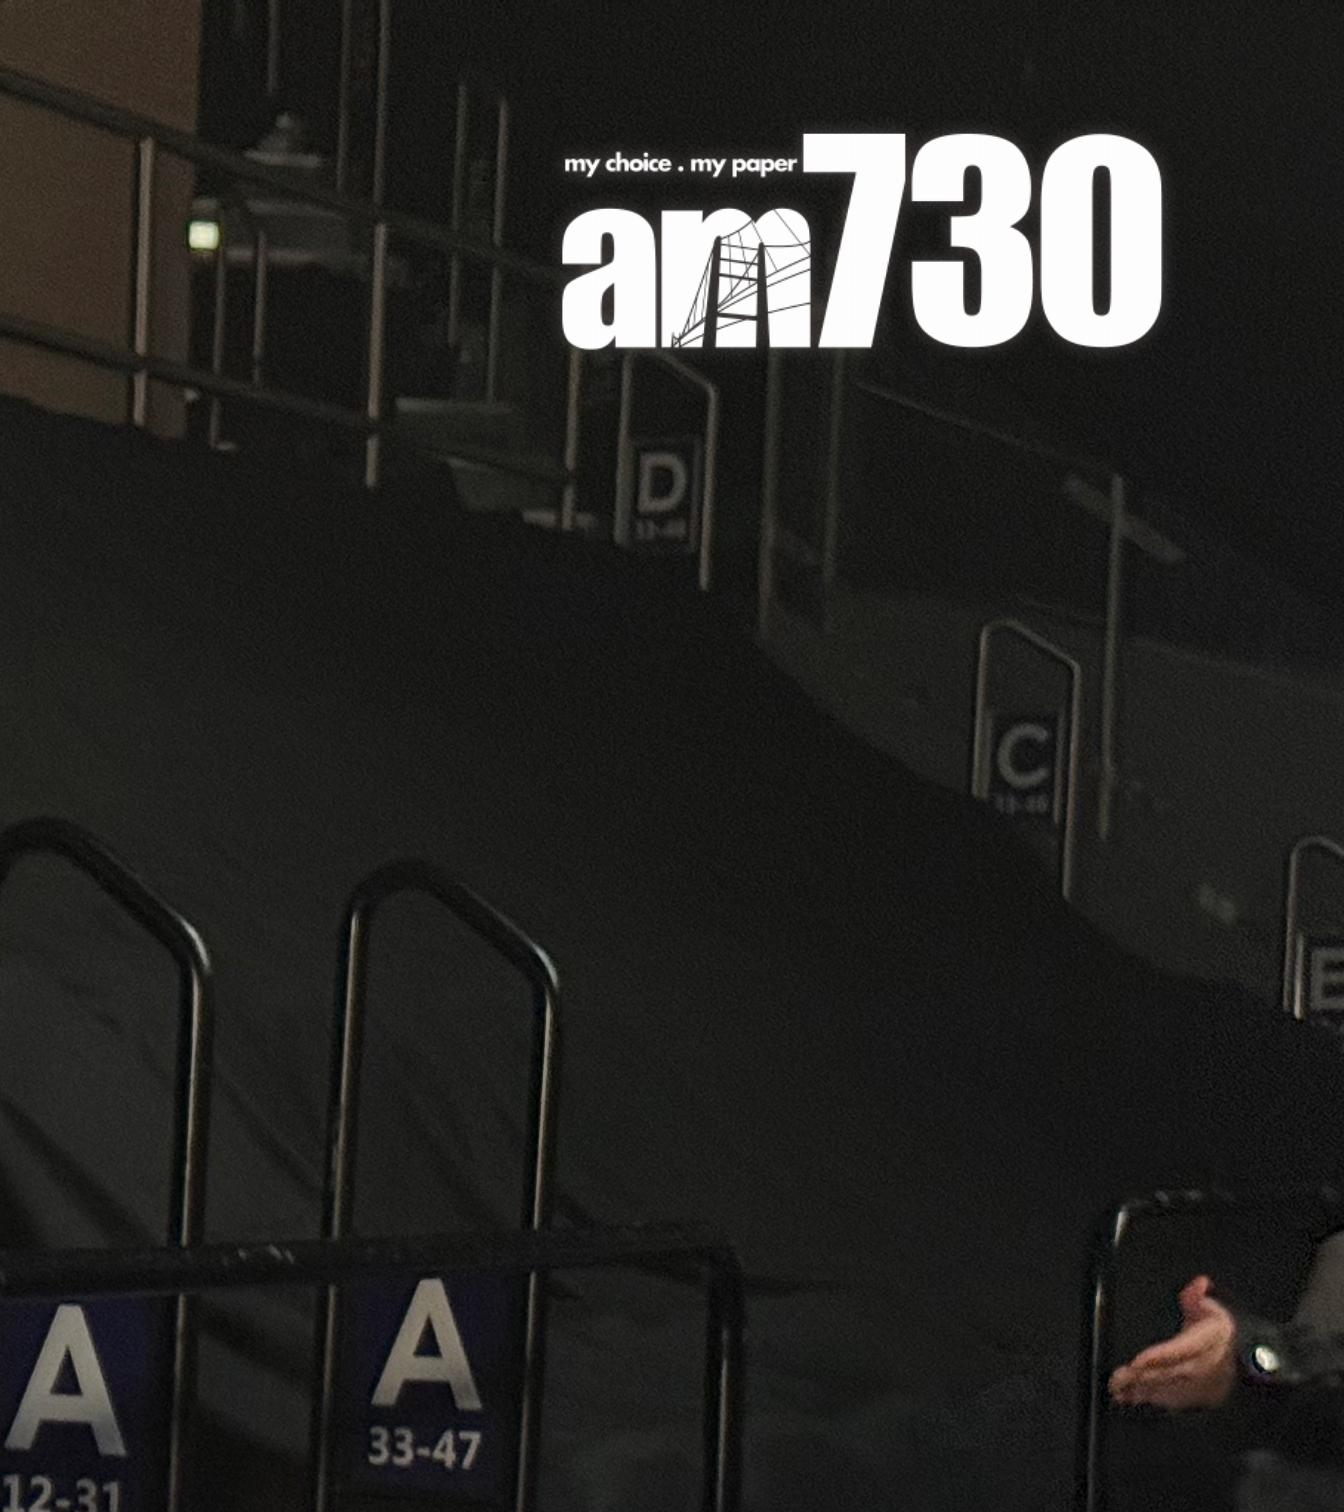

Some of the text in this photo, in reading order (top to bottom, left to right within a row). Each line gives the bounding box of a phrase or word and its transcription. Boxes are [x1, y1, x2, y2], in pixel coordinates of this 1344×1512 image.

[637, 452, 688, 514] D
[997, 723, 1051, 790] C
[372, 1277, 482, 1410] A
[4, 1303, 127, 1457] A
[367, 1426, 483, 1471] 33-47
